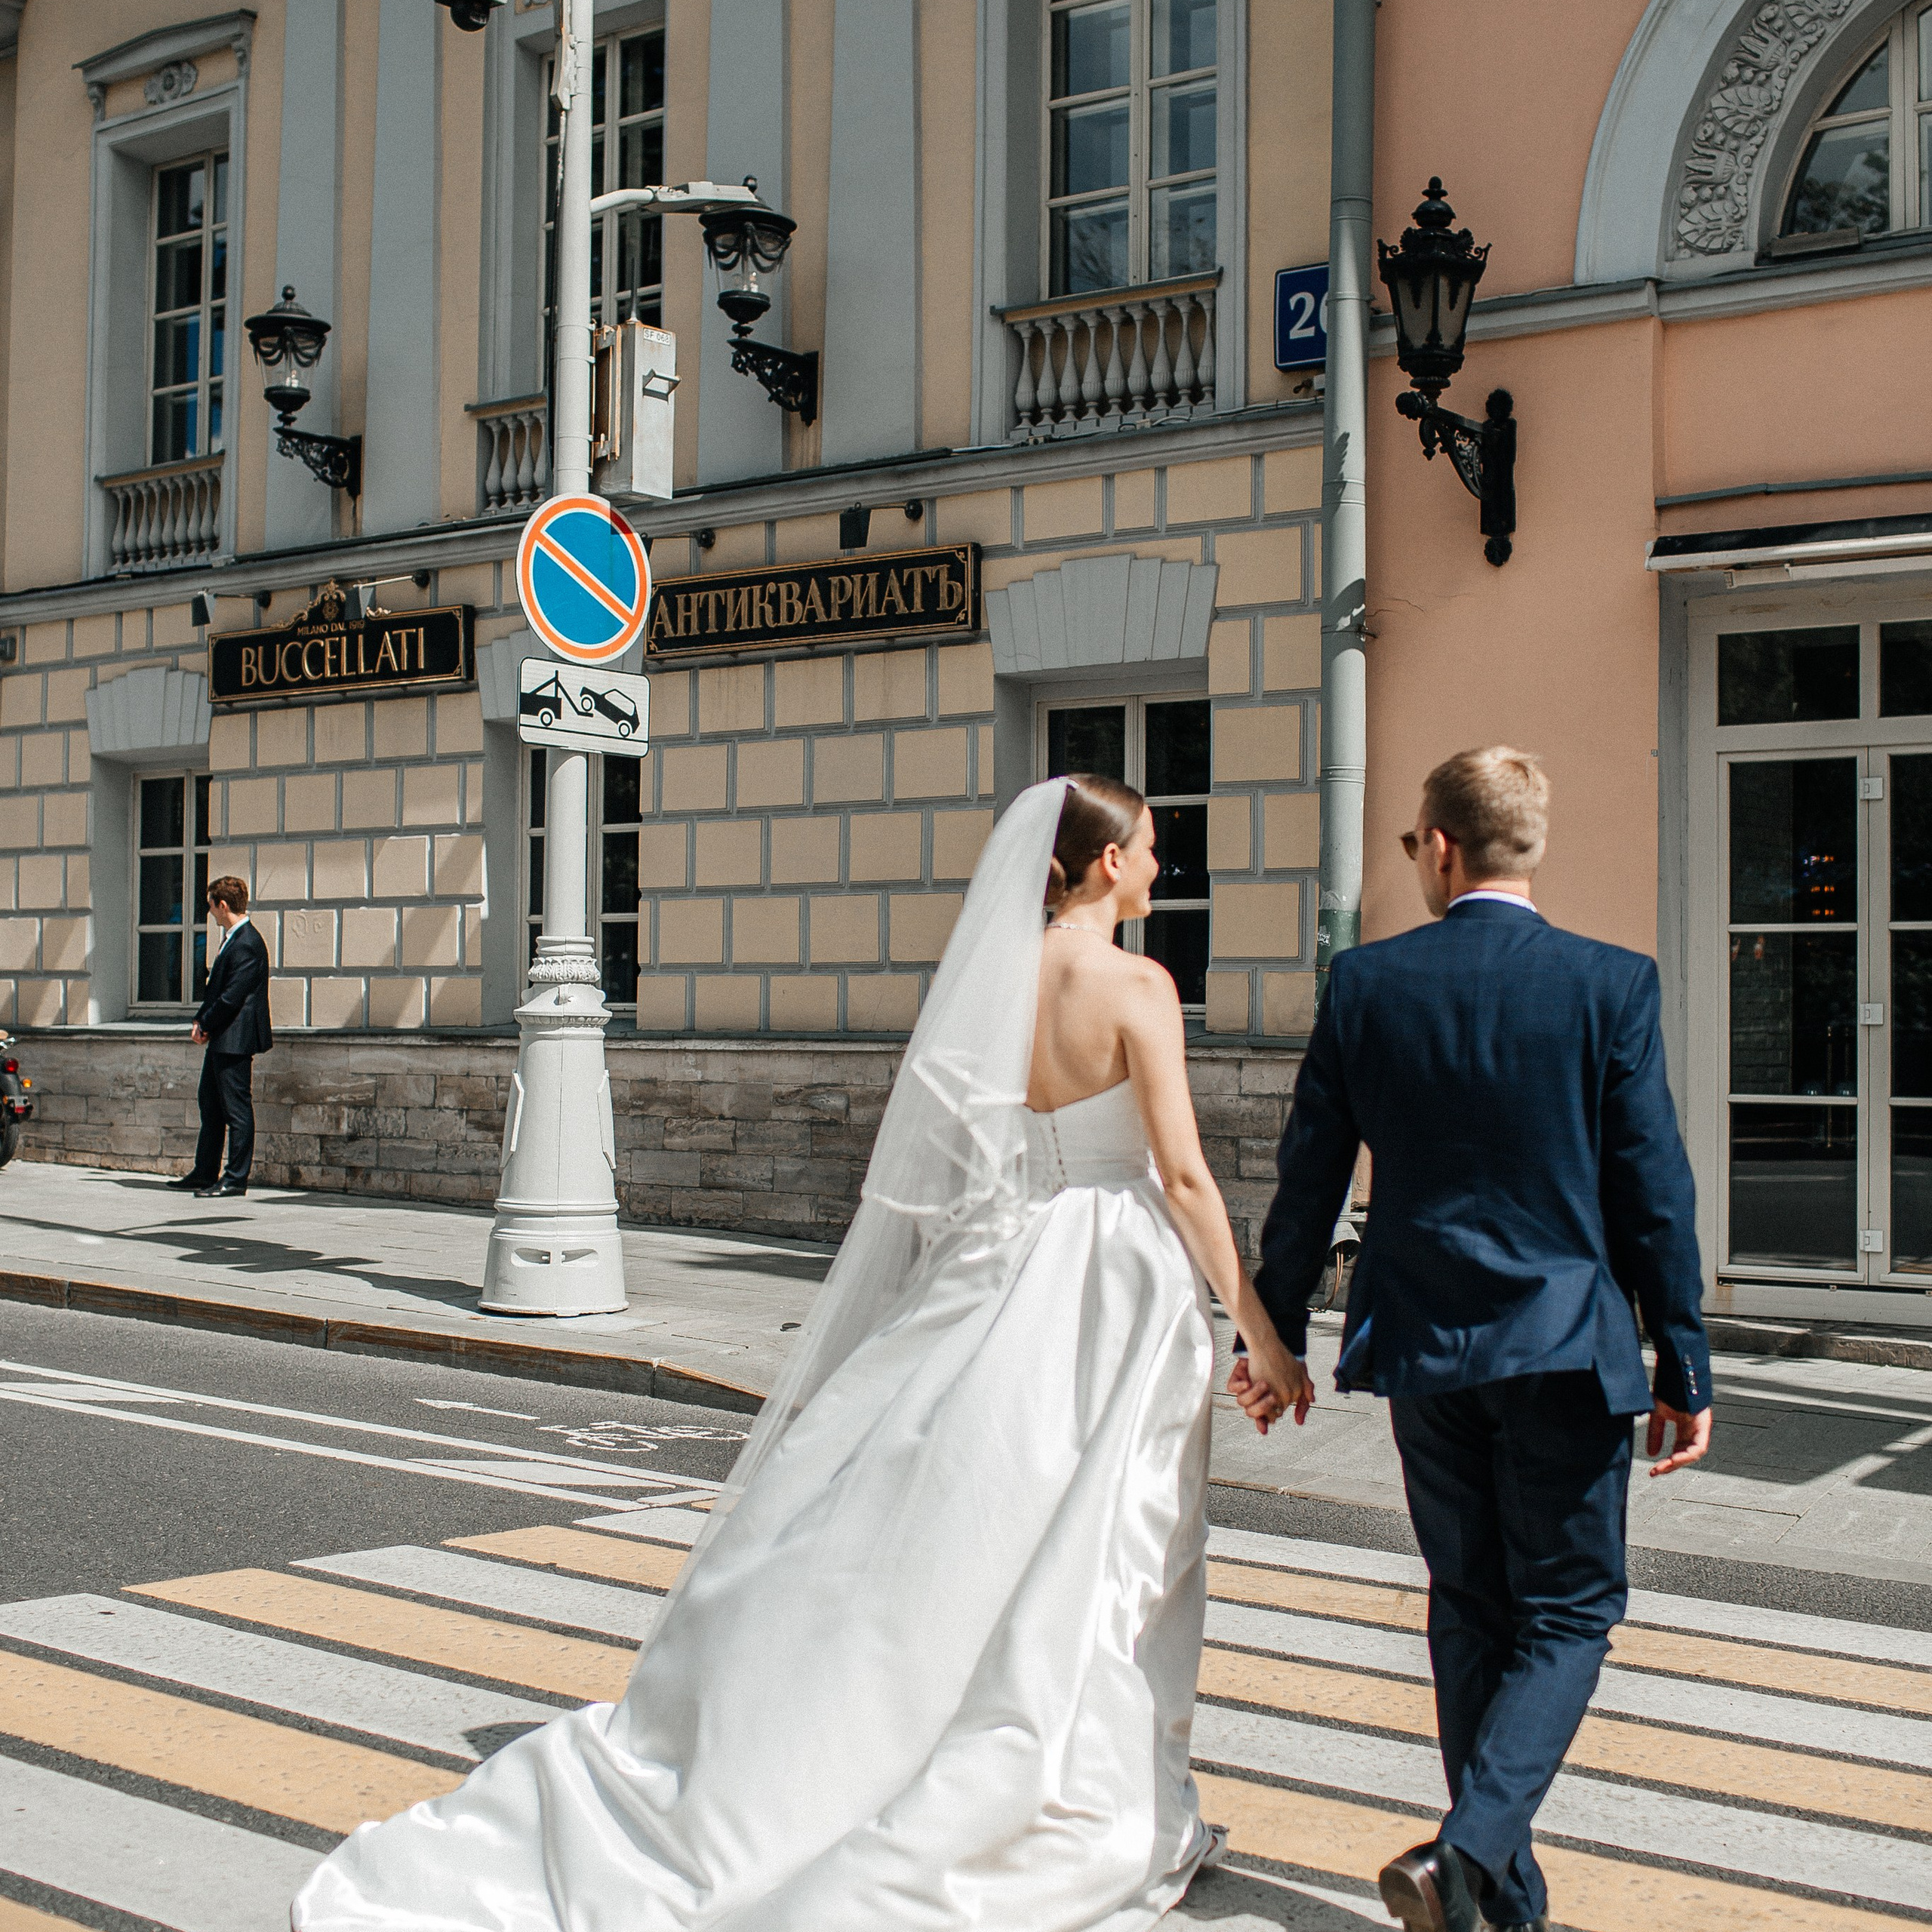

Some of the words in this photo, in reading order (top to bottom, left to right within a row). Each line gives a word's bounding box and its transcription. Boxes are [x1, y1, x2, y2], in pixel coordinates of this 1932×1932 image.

[645, 330, 654, 339] SF
[1289, 291, 1328, 340] 2
[651, 565, 963, 639] АНТИКВАРИАТЪ
[297, 623, 328, 636] MILANO
[331, 622, 347, 632] DAL
[242, 627, 425, 687] BUCCELLATI
